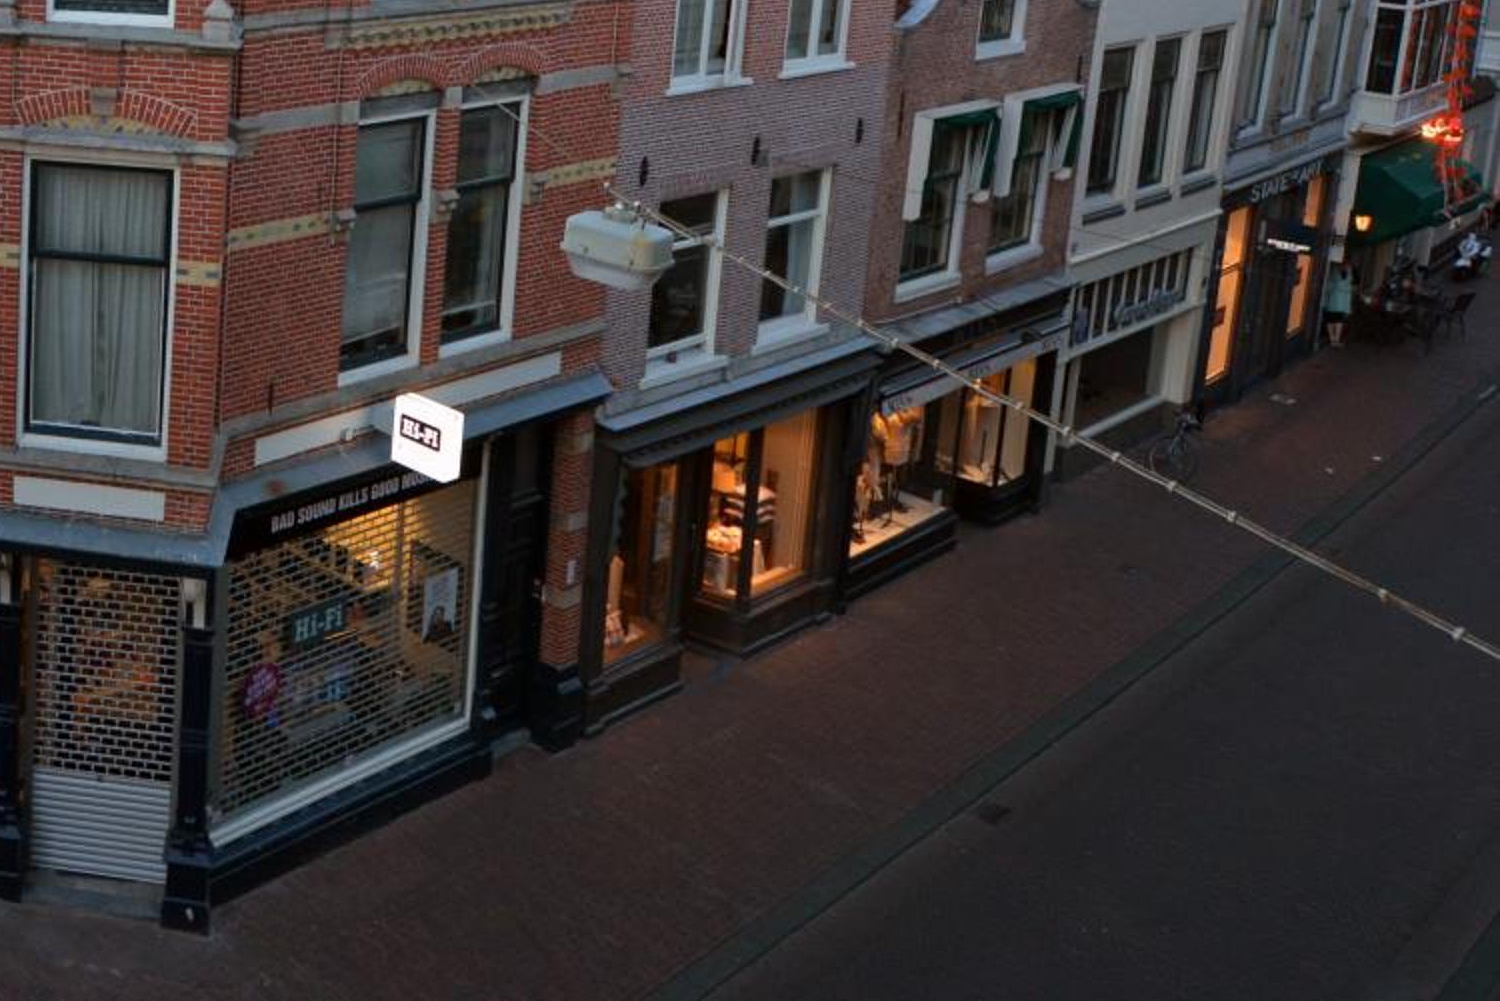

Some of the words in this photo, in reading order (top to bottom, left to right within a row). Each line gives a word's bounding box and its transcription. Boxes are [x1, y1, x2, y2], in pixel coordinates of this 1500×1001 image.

[1251, 171, 1289, 203] STATE
[271, 511, 295, 534] BAD
[296, 497, 337, 523] SOUND
[338, 487, 369, 510] KILLS
[370, 477, 400, 500] GOOD
[295, 606, 342, 642] Hi-Fi
